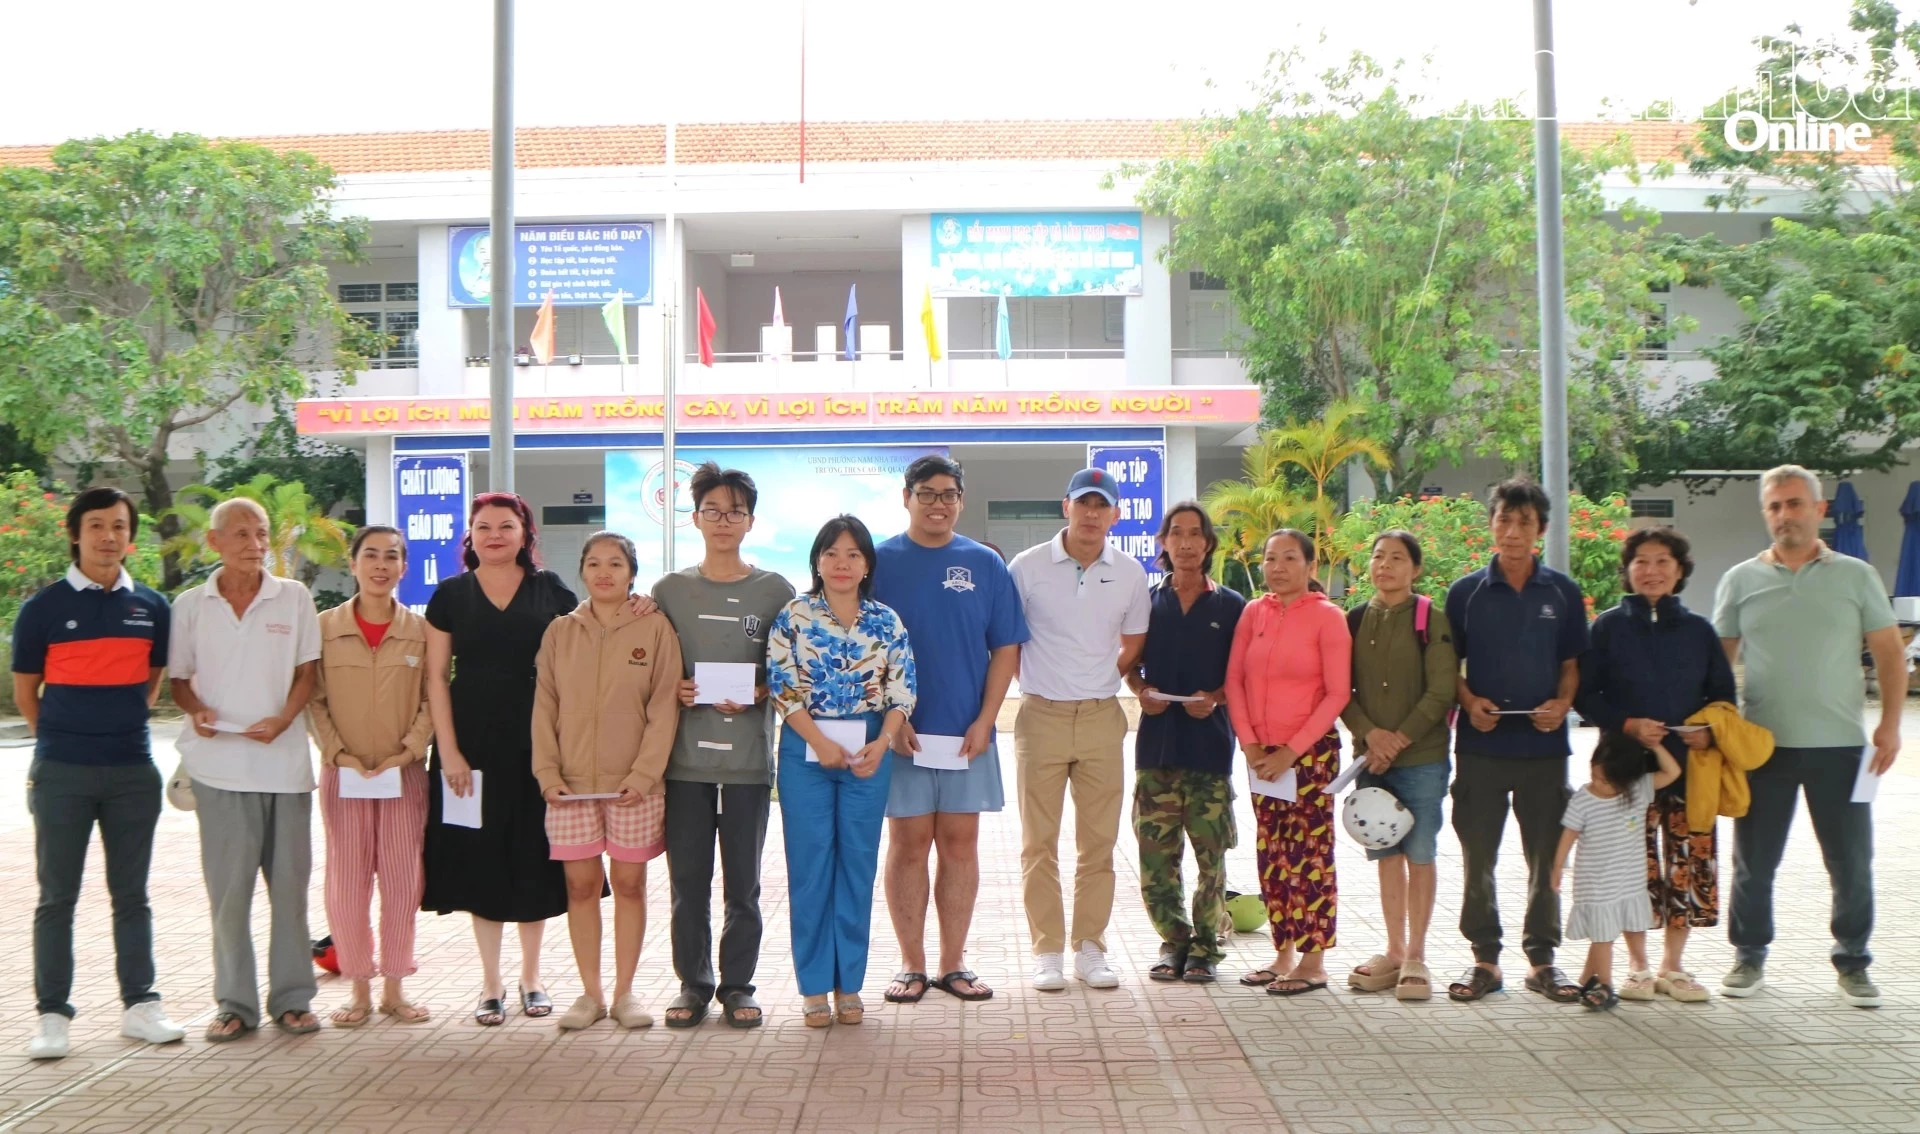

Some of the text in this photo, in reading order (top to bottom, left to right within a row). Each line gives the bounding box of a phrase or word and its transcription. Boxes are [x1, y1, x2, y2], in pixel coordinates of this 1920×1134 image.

[520, 230, 547, 241] NĂM
[577, 229, 600, 241] BÁC
[621, 230, 642, 243] DẠY
[360, 404, 399, 427] LỢI
[407, 401, 450, 422] ÍCH
[528, 400, 583, 419] NĂM
[684, 398, 737, 419] CÂY,
[745, 396, 769, 416] VÌ
[778, 398, 815, 420] LỢI
[824, 396, 867, 416] ÍCH
[877, 395, 943, 415] TRĂM
[952, 394, 1008, 414] NĂM
[1017, 391, 1101, 413] TRỒNG
[1110, 391, 1192, 413] NGƯỜI
[400, 460, 461, 500] CHẤT LƯỢNG
[1128, 456, 1148, 487] TẬP
[408, 508, 454, 545] GIÁO DỤC
[1132, 498, 1152, 525] TẠO
[1107, 531, 1155, 562] ÈN LUYỆN
[424, 553, 439, 585] LÀ
